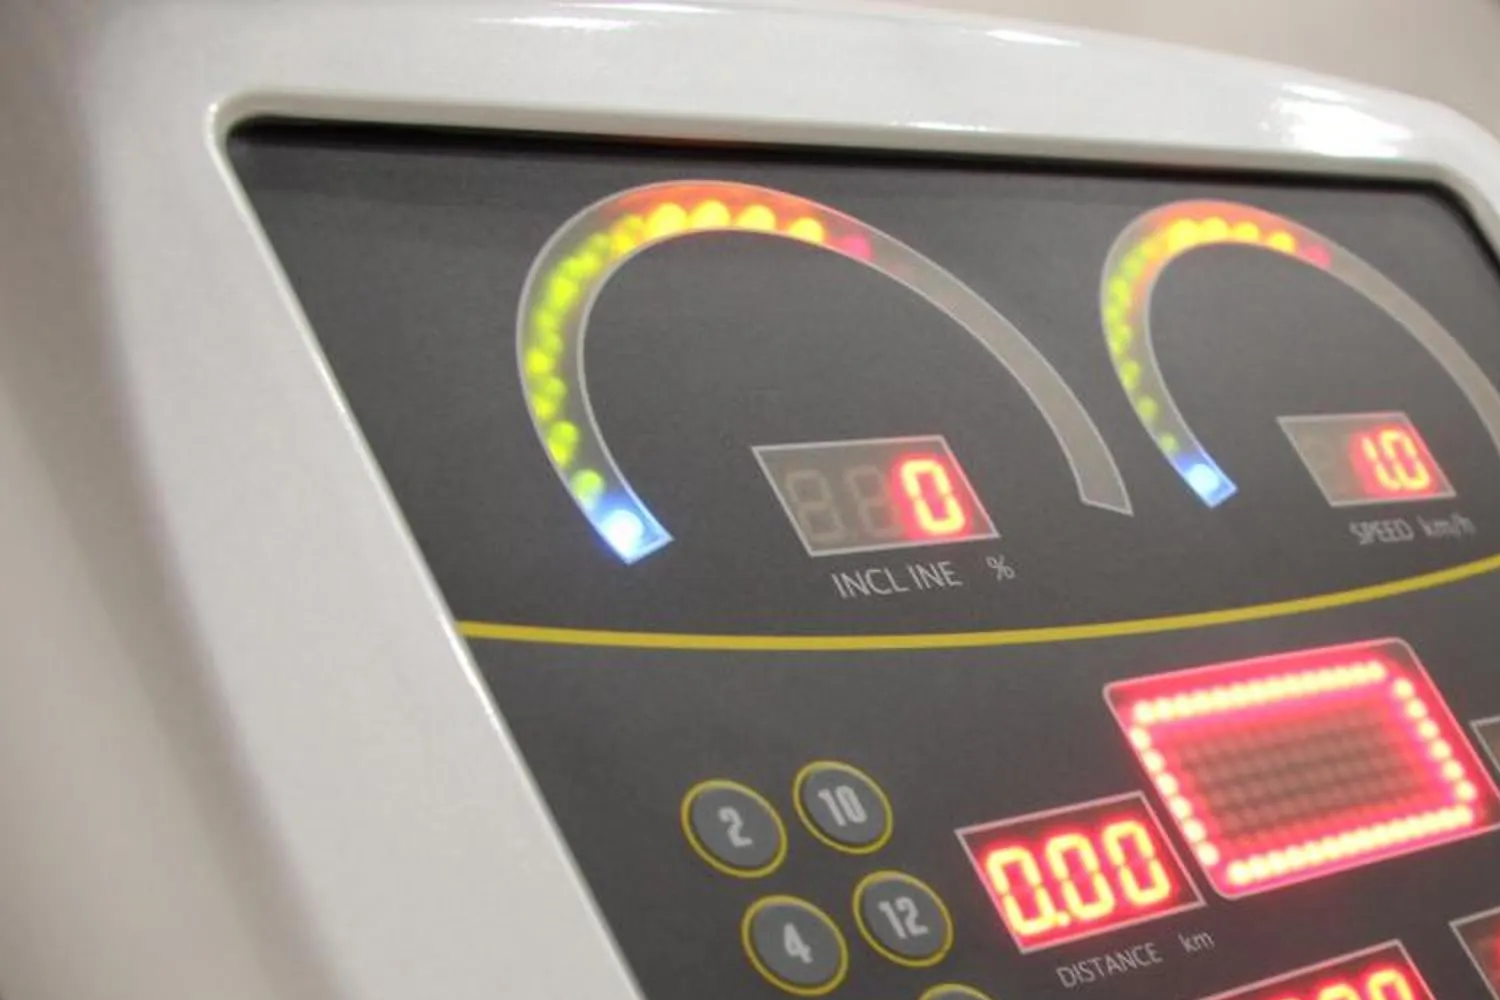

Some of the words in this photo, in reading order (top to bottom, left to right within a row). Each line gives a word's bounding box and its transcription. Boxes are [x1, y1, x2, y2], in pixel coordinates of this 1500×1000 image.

[900, 458, 966, 535] 0
[1349, 518, 1415, 545] SPEED
[831, 561, 963, 599] INCLINE
[718, 806, 753, 848] 2
[818, 784, 868, 827] 10
[985, 818, 1171, 936] 0.00
[877, 896, 929, 940] 12
[783, 922, 813, 964] 4
[1055, 942, 1164, 989] DISTANCE
[1178, 931, 1215, 953] km
